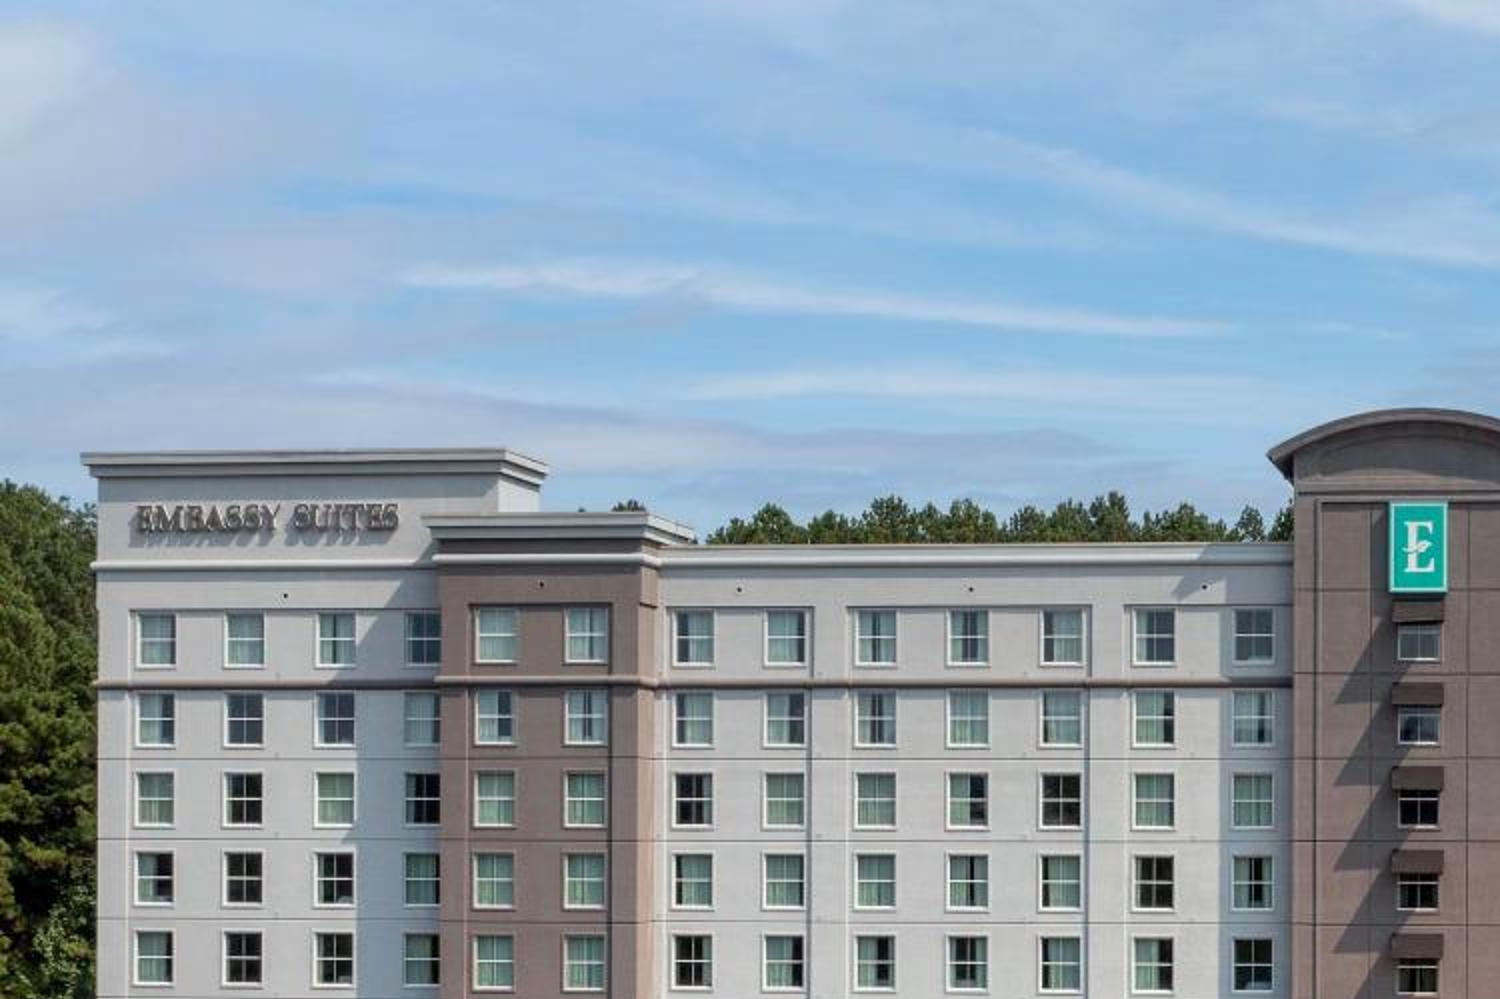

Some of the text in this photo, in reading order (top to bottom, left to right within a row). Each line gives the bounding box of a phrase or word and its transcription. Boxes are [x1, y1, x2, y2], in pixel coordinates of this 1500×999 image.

[136, 503, 399, 533] EMBASSY SUITES
[1401, 521, 1435, 573] E
